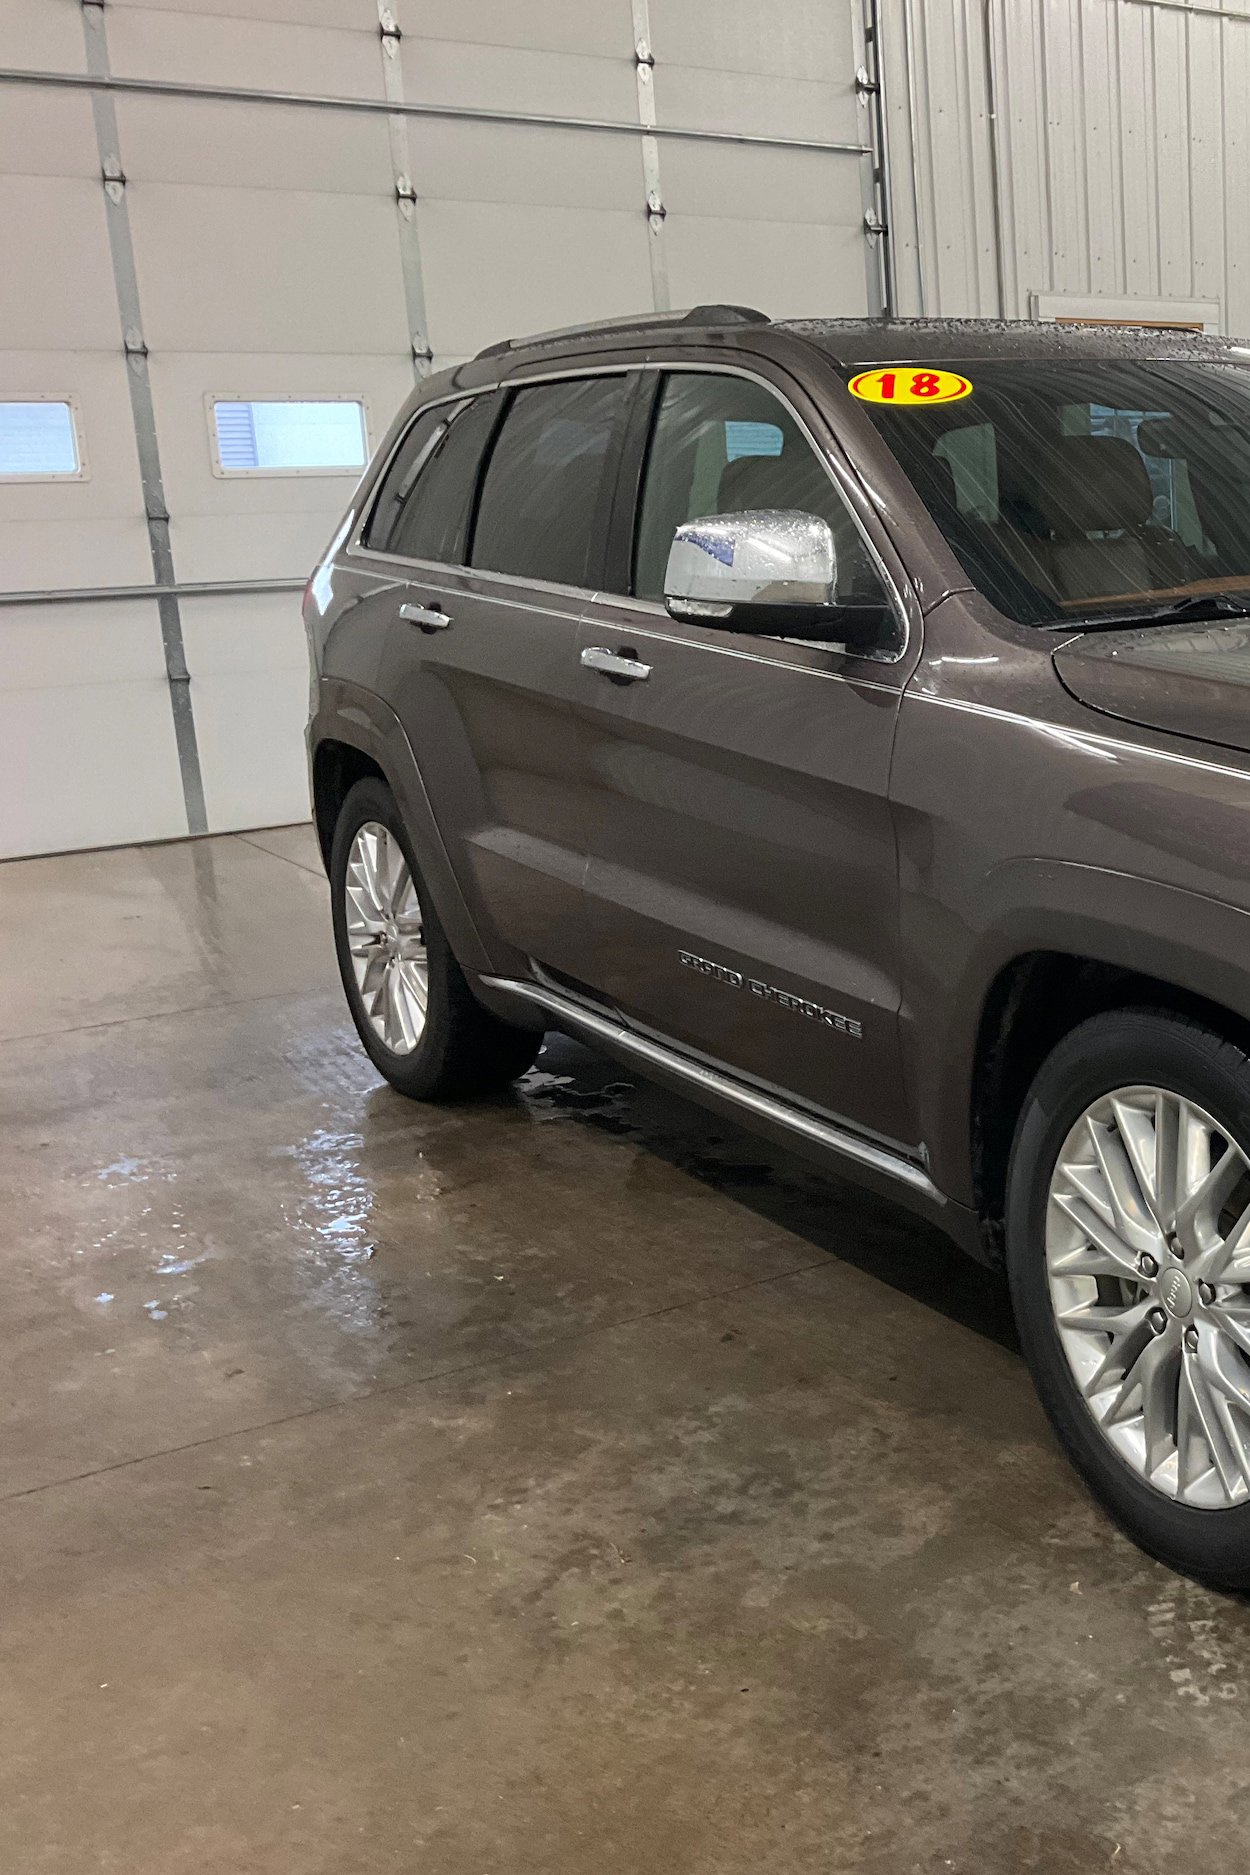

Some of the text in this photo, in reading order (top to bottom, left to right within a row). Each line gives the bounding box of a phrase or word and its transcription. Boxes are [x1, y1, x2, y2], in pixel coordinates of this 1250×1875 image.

[876, 373, 940, 398] 18
[678, 949, 862, 1039] GRAND CHEROKEE
